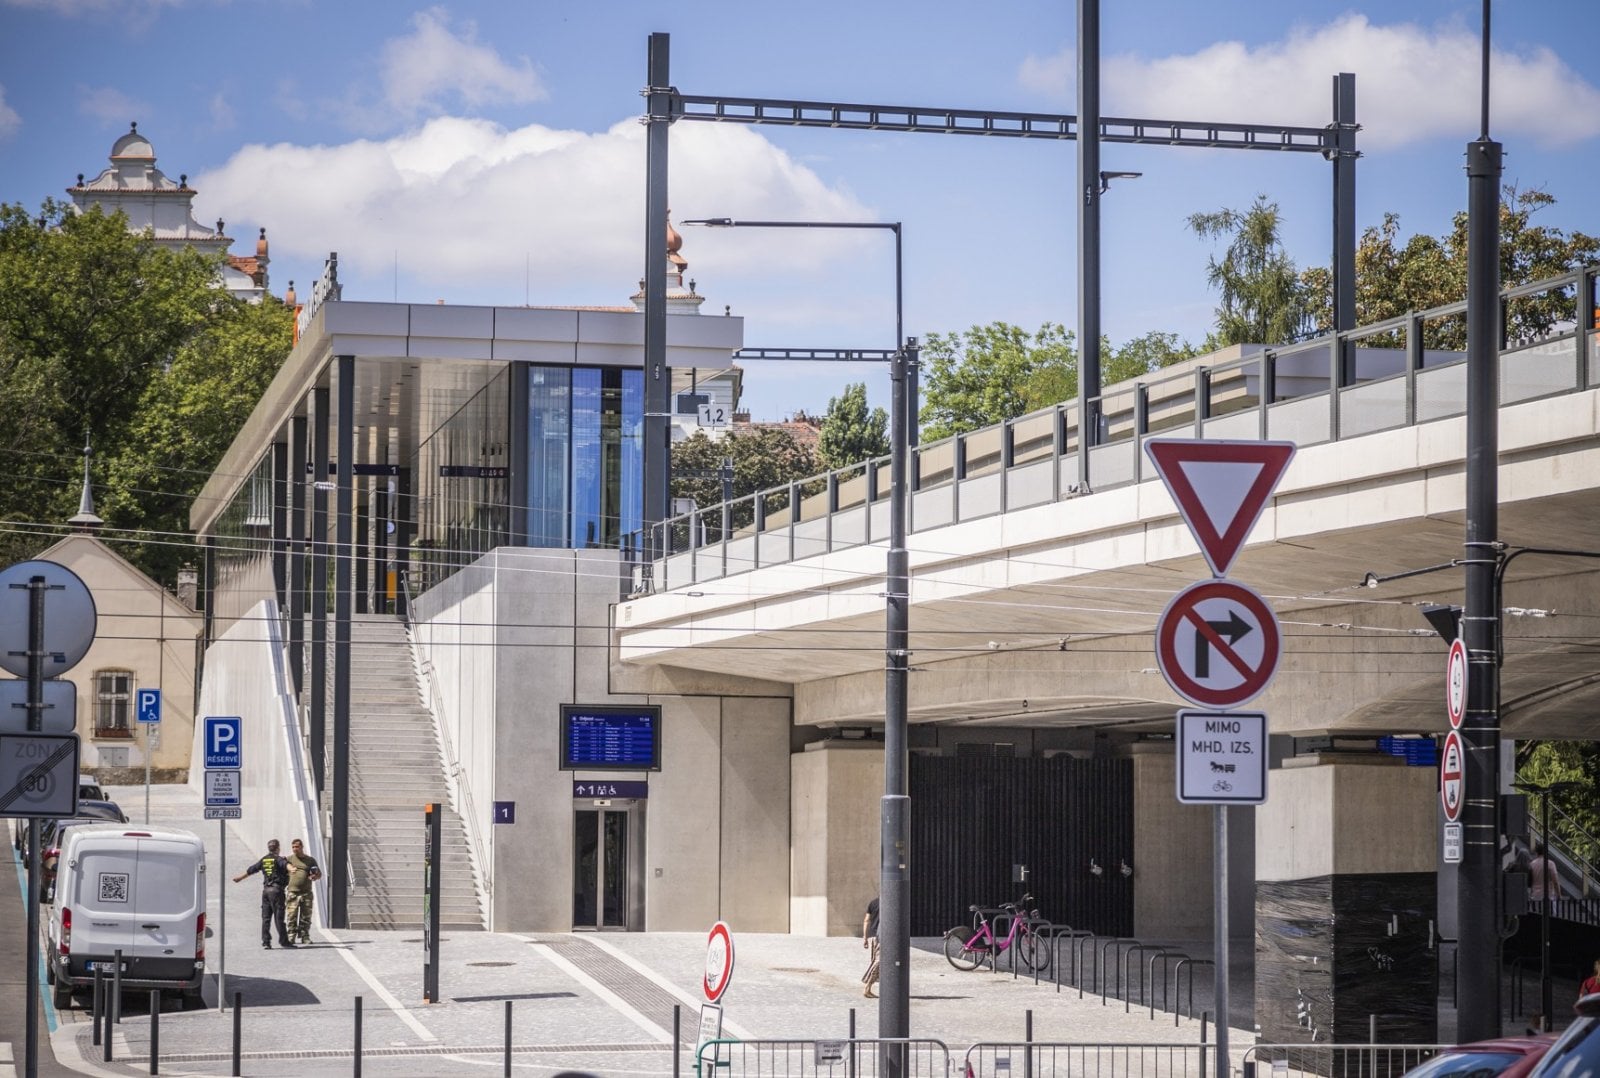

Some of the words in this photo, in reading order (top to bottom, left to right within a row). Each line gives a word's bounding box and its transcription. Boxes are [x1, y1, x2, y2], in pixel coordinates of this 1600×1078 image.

[704, 408, 724, 424] 1,2
[142, 693, 156, 712] P
[1206, 721, 1240, 733] MIMO
[214, 724, 235, 753] P
[588, 785, 594, 795] 1
[502, 808, 508, 818] 1
